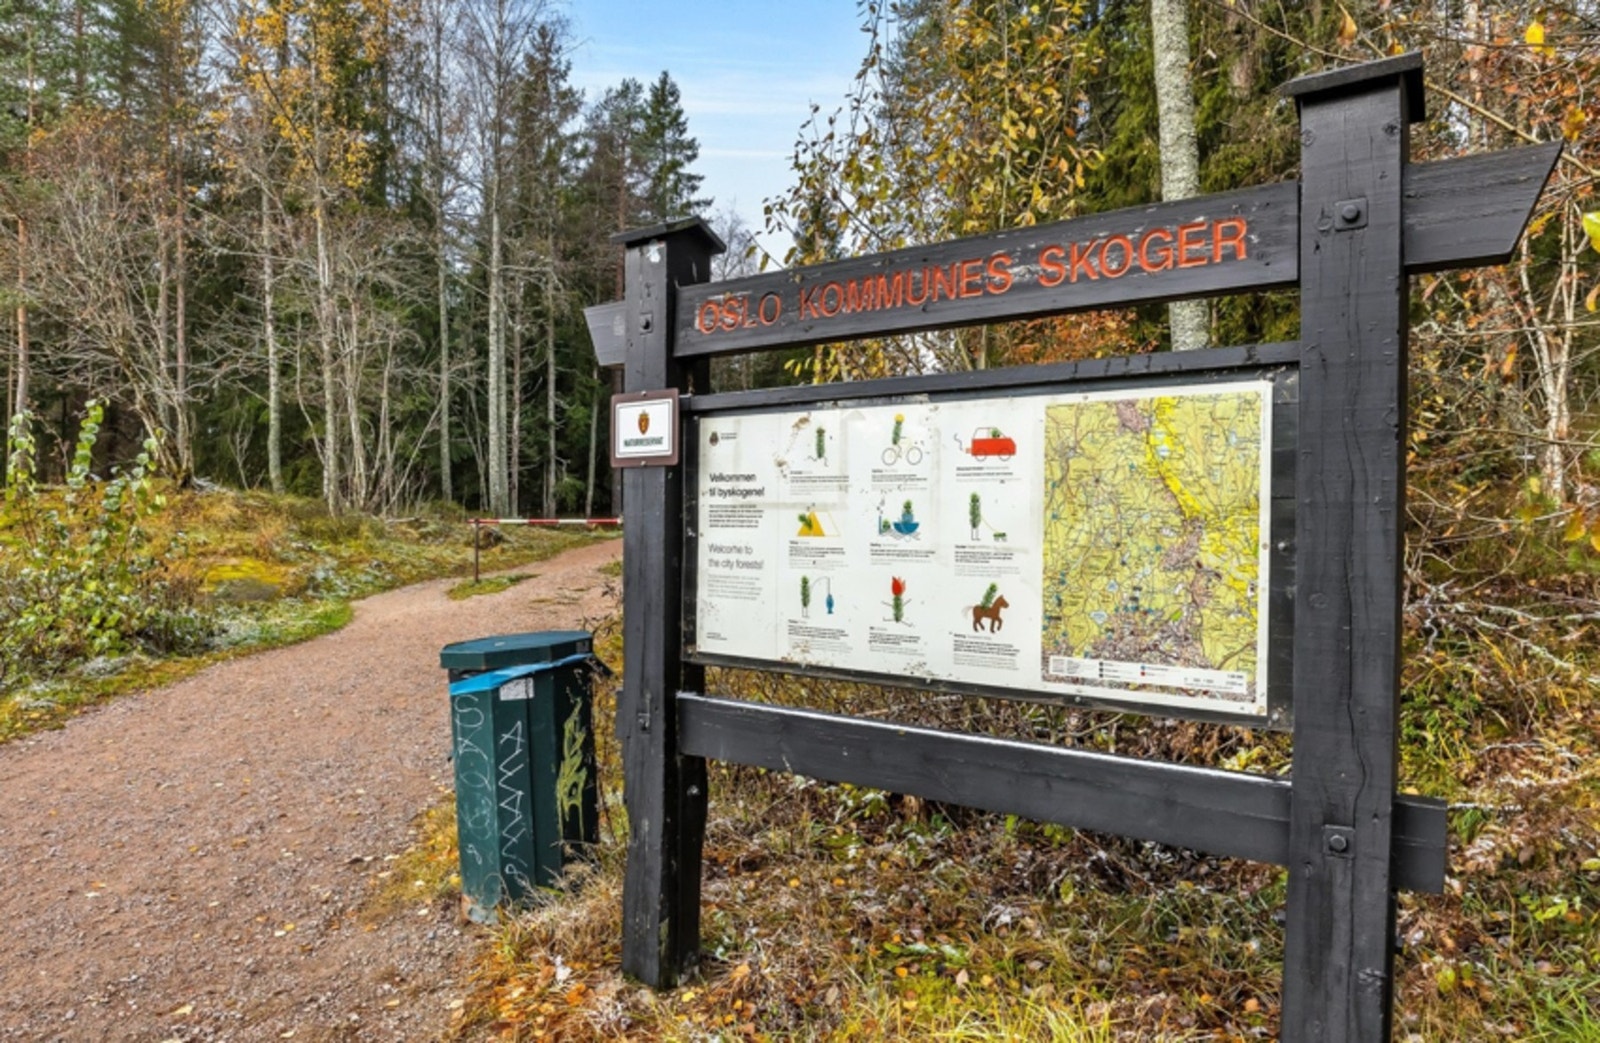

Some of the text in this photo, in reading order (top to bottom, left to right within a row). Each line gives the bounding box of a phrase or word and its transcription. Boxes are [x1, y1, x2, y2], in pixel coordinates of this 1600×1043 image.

[699, 216, 1248, 335] OSLO KOMMUNES SKOGER
[709, 472, 756, 483] Velkommen
[708, 543, 743, 554] Welcome
